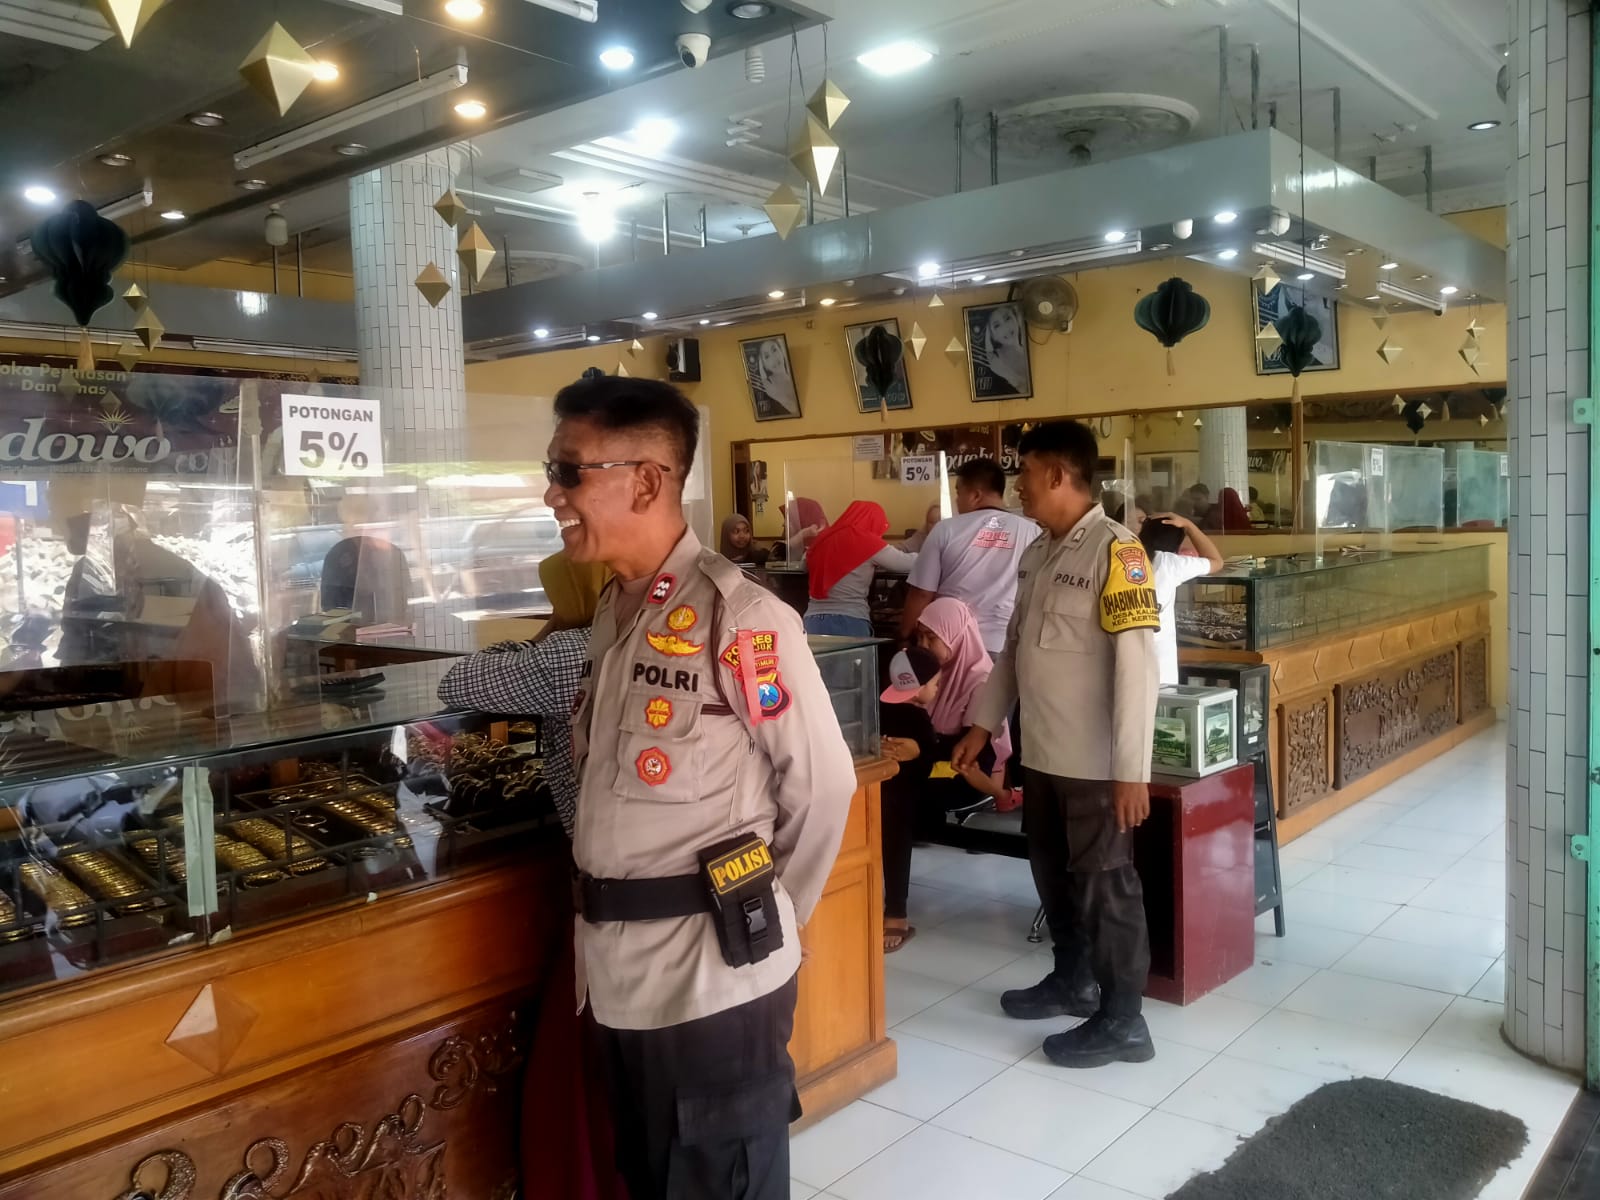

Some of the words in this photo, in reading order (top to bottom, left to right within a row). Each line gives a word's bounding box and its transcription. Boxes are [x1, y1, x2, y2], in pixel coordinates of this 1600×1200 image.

[0, 360, 33, 377] oko
[21, 379, 57, 393] Dan
[288, 405, 374, 423] POTONGAN
[299, 430, 369, 471] 5%
[905, 466, 930, 482] 5%
[1054, 572, 1091, 589] POLRI
[1112, 611, 1134, 620] DESA
[632, 661, 699, 693] POLRI
[711, 845, 772, 890] POLISI
